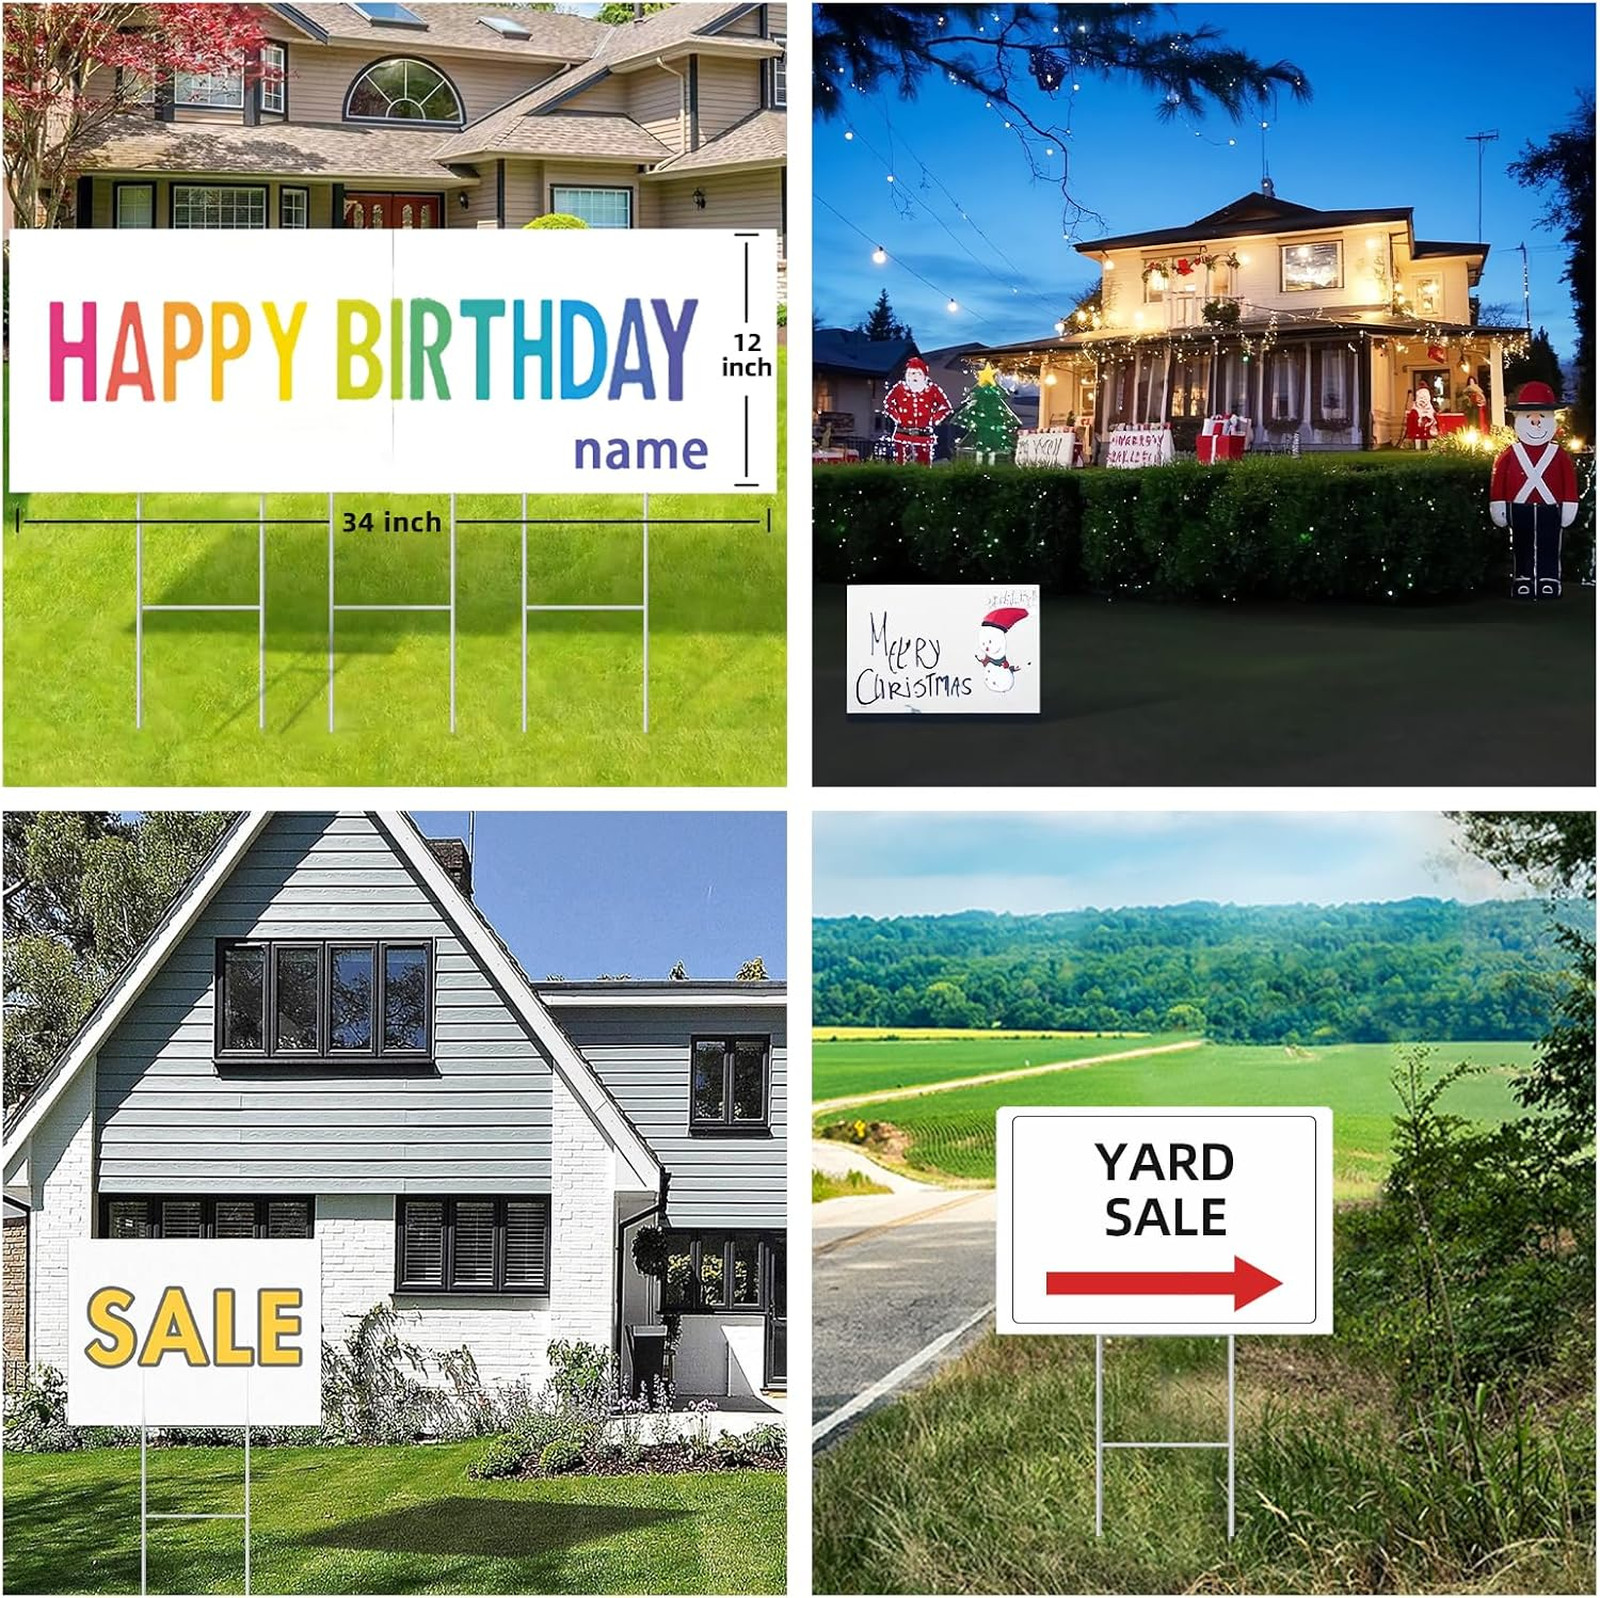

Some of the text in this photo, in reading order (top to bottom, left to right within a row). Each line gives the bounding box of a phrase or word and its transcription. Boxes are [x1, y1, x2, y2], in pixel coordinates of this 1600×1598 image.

[50, 298, 699, 402] HAPPY BIRTHDAY
[575, 437, 709, 470] name
[1095, 1143, 1235, 1181] YARD
[1105, 1197, 1227, 1237] SALE
[84, 1286, 303, 1369] SALE
